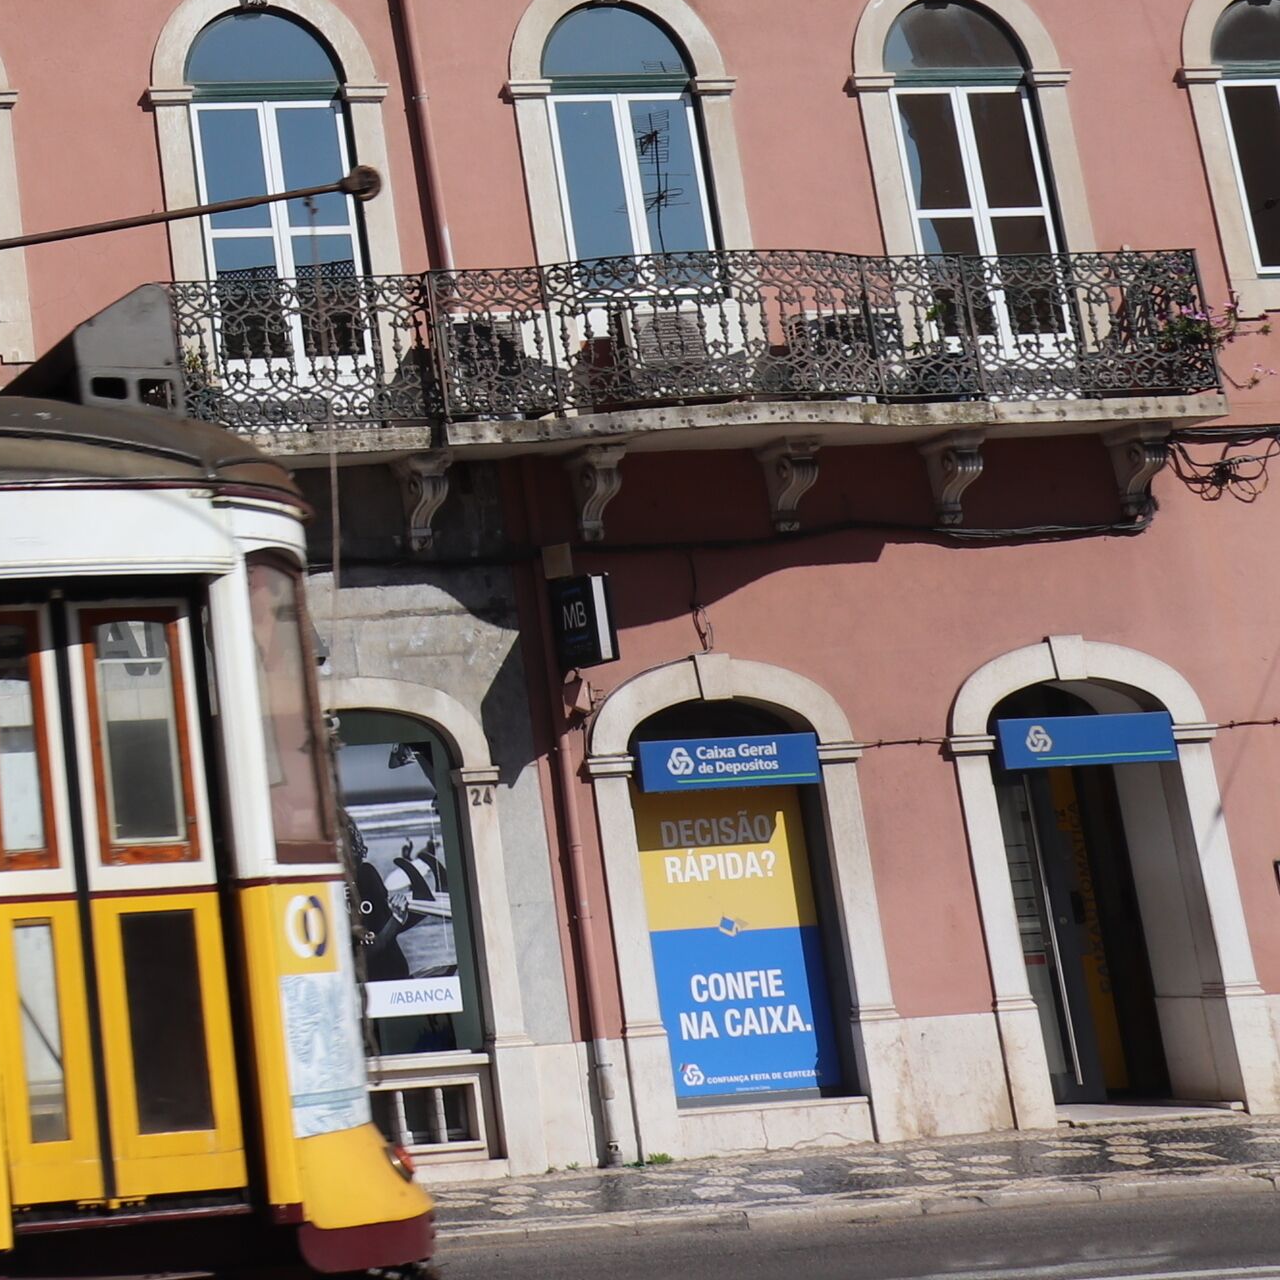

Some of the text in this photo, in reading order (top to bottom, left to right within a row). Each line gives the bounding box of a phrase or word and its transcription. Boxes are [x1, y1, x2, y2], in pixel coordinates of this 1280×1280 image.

[562, 601, 587, 630] MB
[696, 741, 778, 760] Caixa Geral
[698, 762, 714, 774] de
[470, 786, 493, 806] 24
[660, 810, 771, 848] DECISÃO
[664, 849, 776, 884] RÁPIDA?
[690, 969, 785, 1003] CONFIE
[679, 1004, 812, 1040] NA CAIXA.
[706, 1074, 750, 1085] CONFIANÇA
[750, 1072, 770, 1082] FEITA
[771, 1071, 782, 1080] DE
